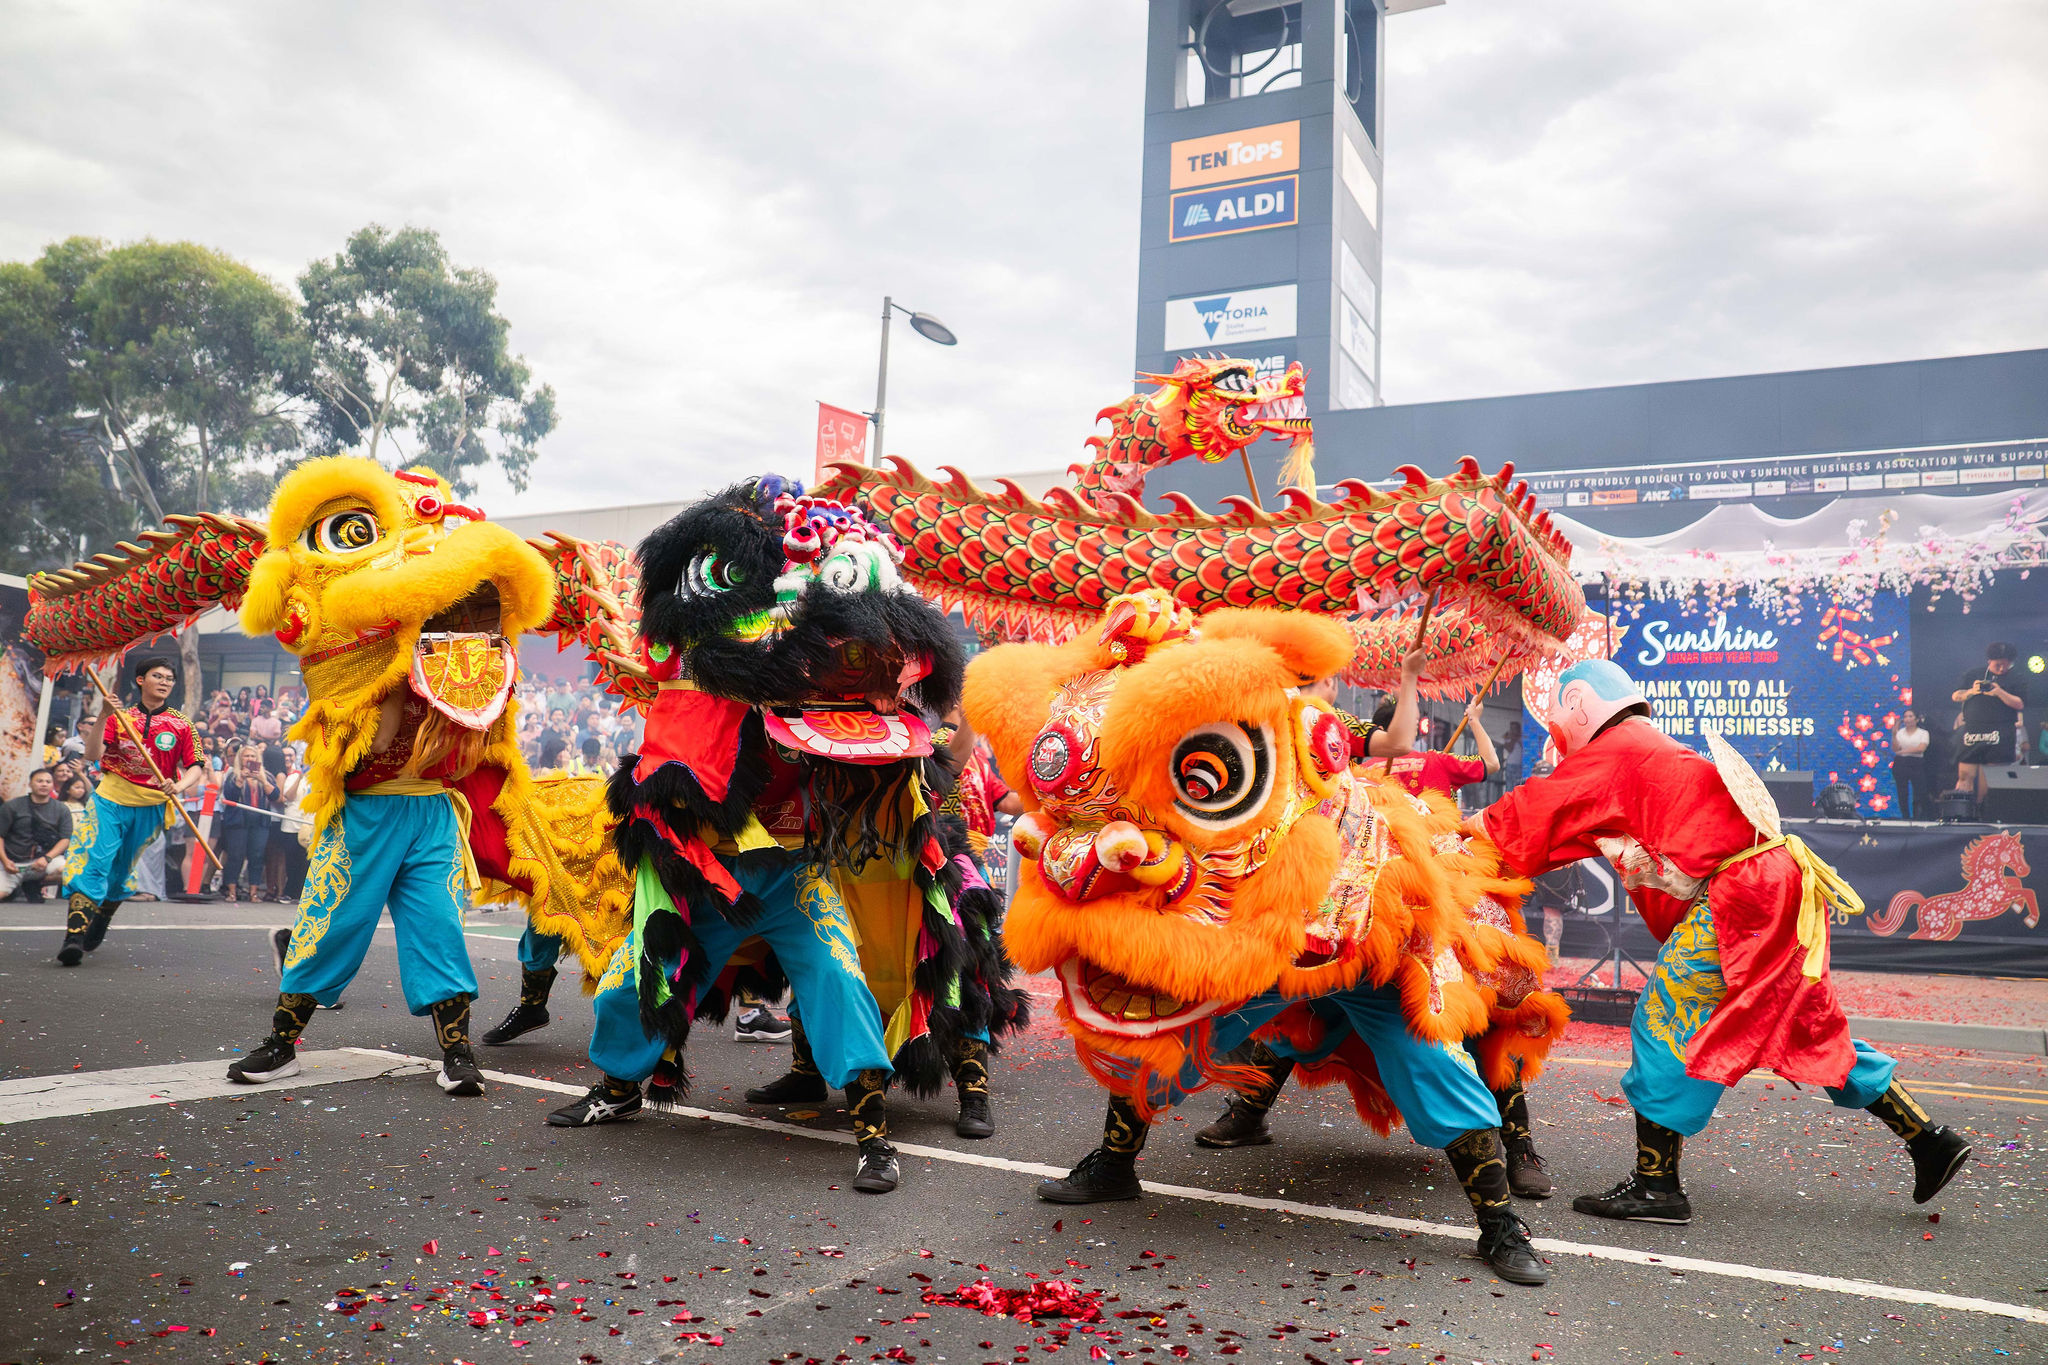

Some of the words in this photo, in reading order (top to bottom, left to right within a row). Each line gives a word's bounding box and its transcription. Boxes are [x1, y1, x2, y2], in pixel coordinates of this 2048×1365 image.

[1215, 191, 1285, 222] ALDI
[1201, 306, 1268, 324] VICTORIA
[1534, 480, 1565, 490] EVENT
[1570, 479, 1580, 489] IS
[1584, 476, 1630, 488] PROUDLY
[1635, 473, 1684, 485] BROUGHT
[1689, 473, 1701, 481] TO
[1707, 471, 1727, 480] YOU
[1732, 469, 1745, 479] BY
[1751, 466, 1807, 478] SUNSHINE
[1813, 461, 1871, 474] BUSINESS
[1876, 456, 1957, 470] ASSOCIATION
[1963, 453, 1995, 464] WITH
[1642, 490, 1670, 502] ANZ
[1638, 614, 1779, 666] Sunshine
[1666, 652, 1699, 664] LUNAR
[1701, 652, 1724, 664] NEW
[1726, 651, 1751, 663] YEAR
[1753, 651, 1779, 663] 2026
[1635, 680, 1682, 698] HANK
[1686, 680, 1722, 697] YOU
[1727, 680, 1750, 697] TO
[1755, 680, 1789, 697] ALL
[1694, 699, 1788, 716] FABULOUS
[1652, 718, 1694, 735] HINE
[1700, 718, 1815, 736] BUSINESSES
[1361, 812, 1375, 849] Carpent
[1828, 905, 1849, 926] 26
